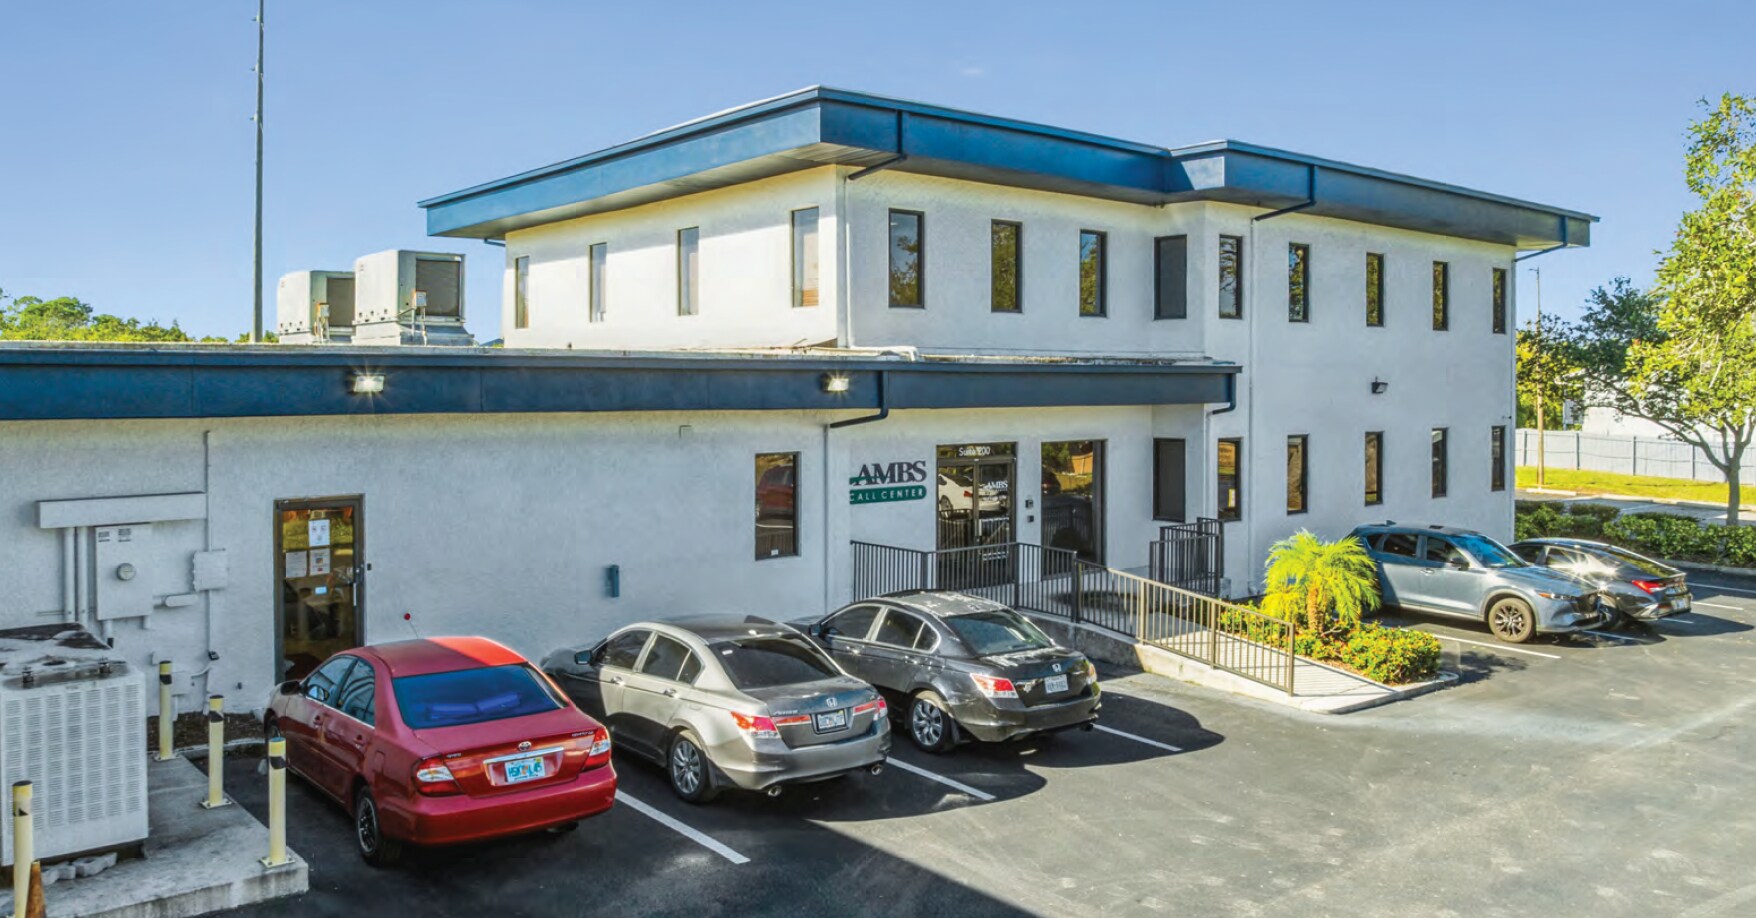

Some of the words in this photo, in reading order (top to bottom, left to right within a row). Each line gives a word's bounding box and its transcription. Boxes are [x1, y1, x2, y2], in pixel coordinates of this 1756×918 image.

[852, 460, 927, 486] AMBS
[983, 480, 1008, 489] AMBS
[881, 488, 923, 500] CENTER
